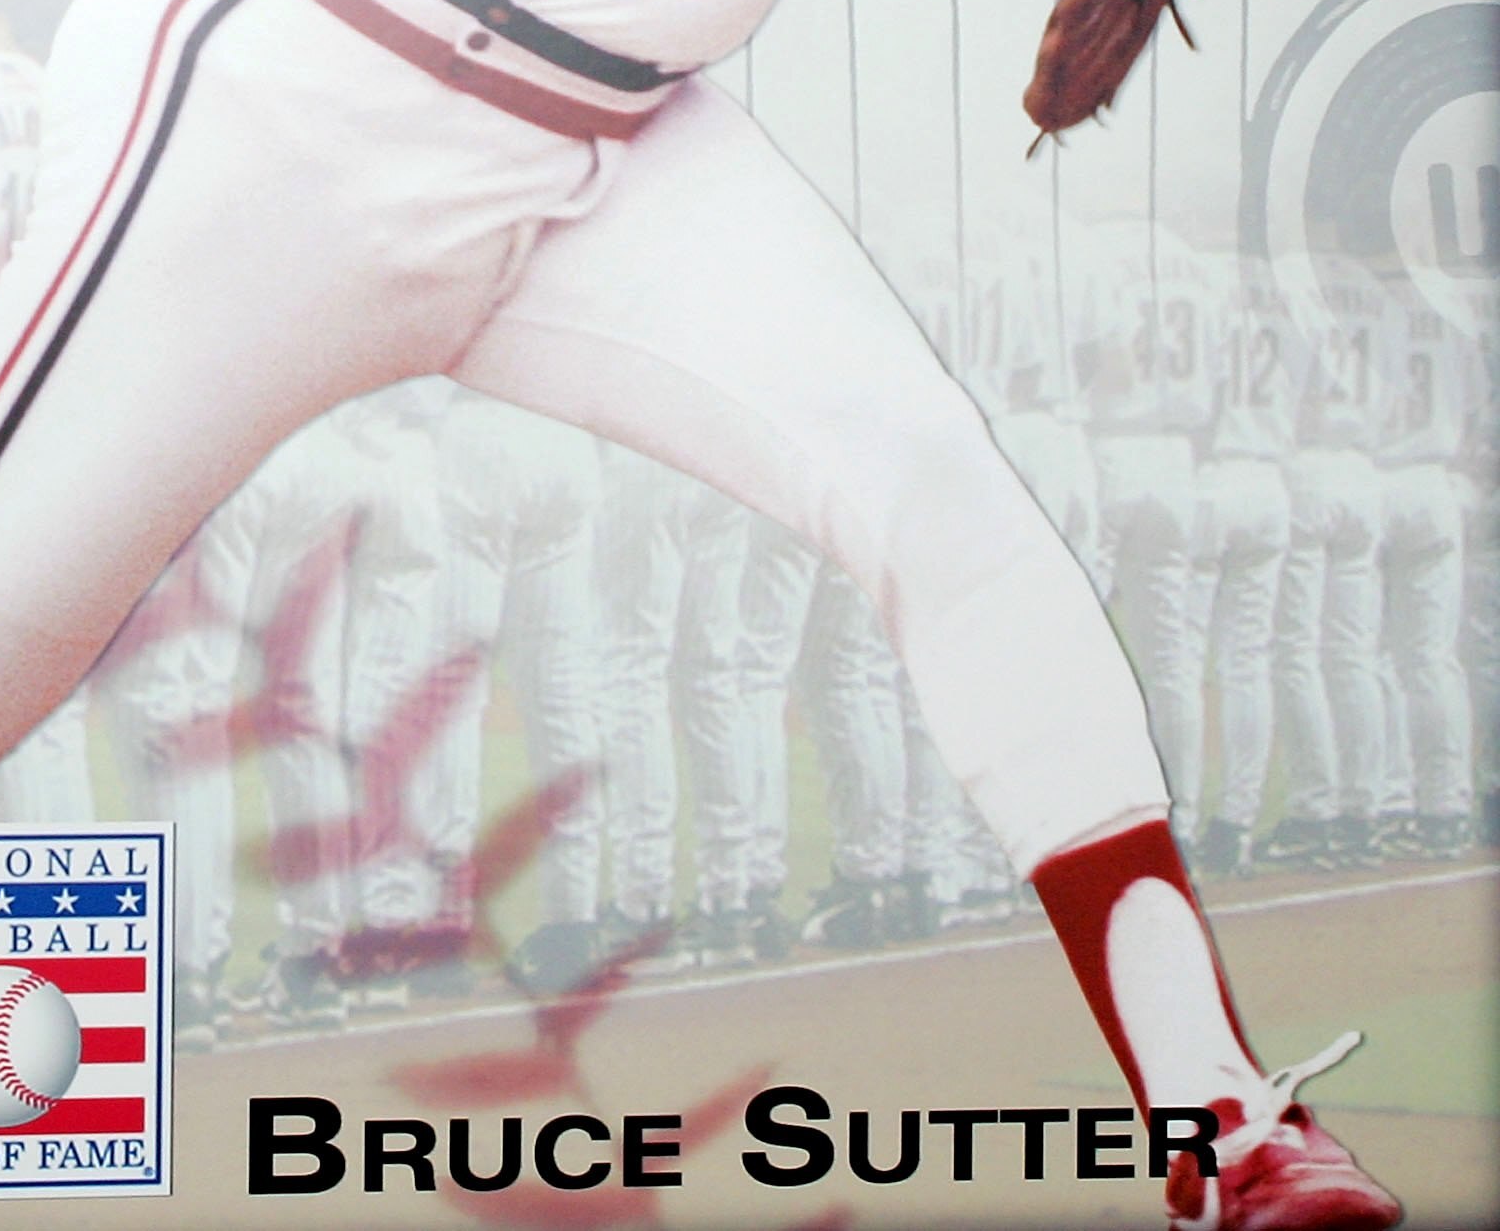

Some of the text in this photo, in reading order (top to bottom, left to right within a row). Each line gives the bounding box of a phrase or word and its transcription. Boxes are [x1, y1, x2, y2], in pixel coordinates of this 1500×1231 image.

[38, 1140, 146, 1169] FAME
[247, 1084, 1220, 1197] BRUCE SUTTER
